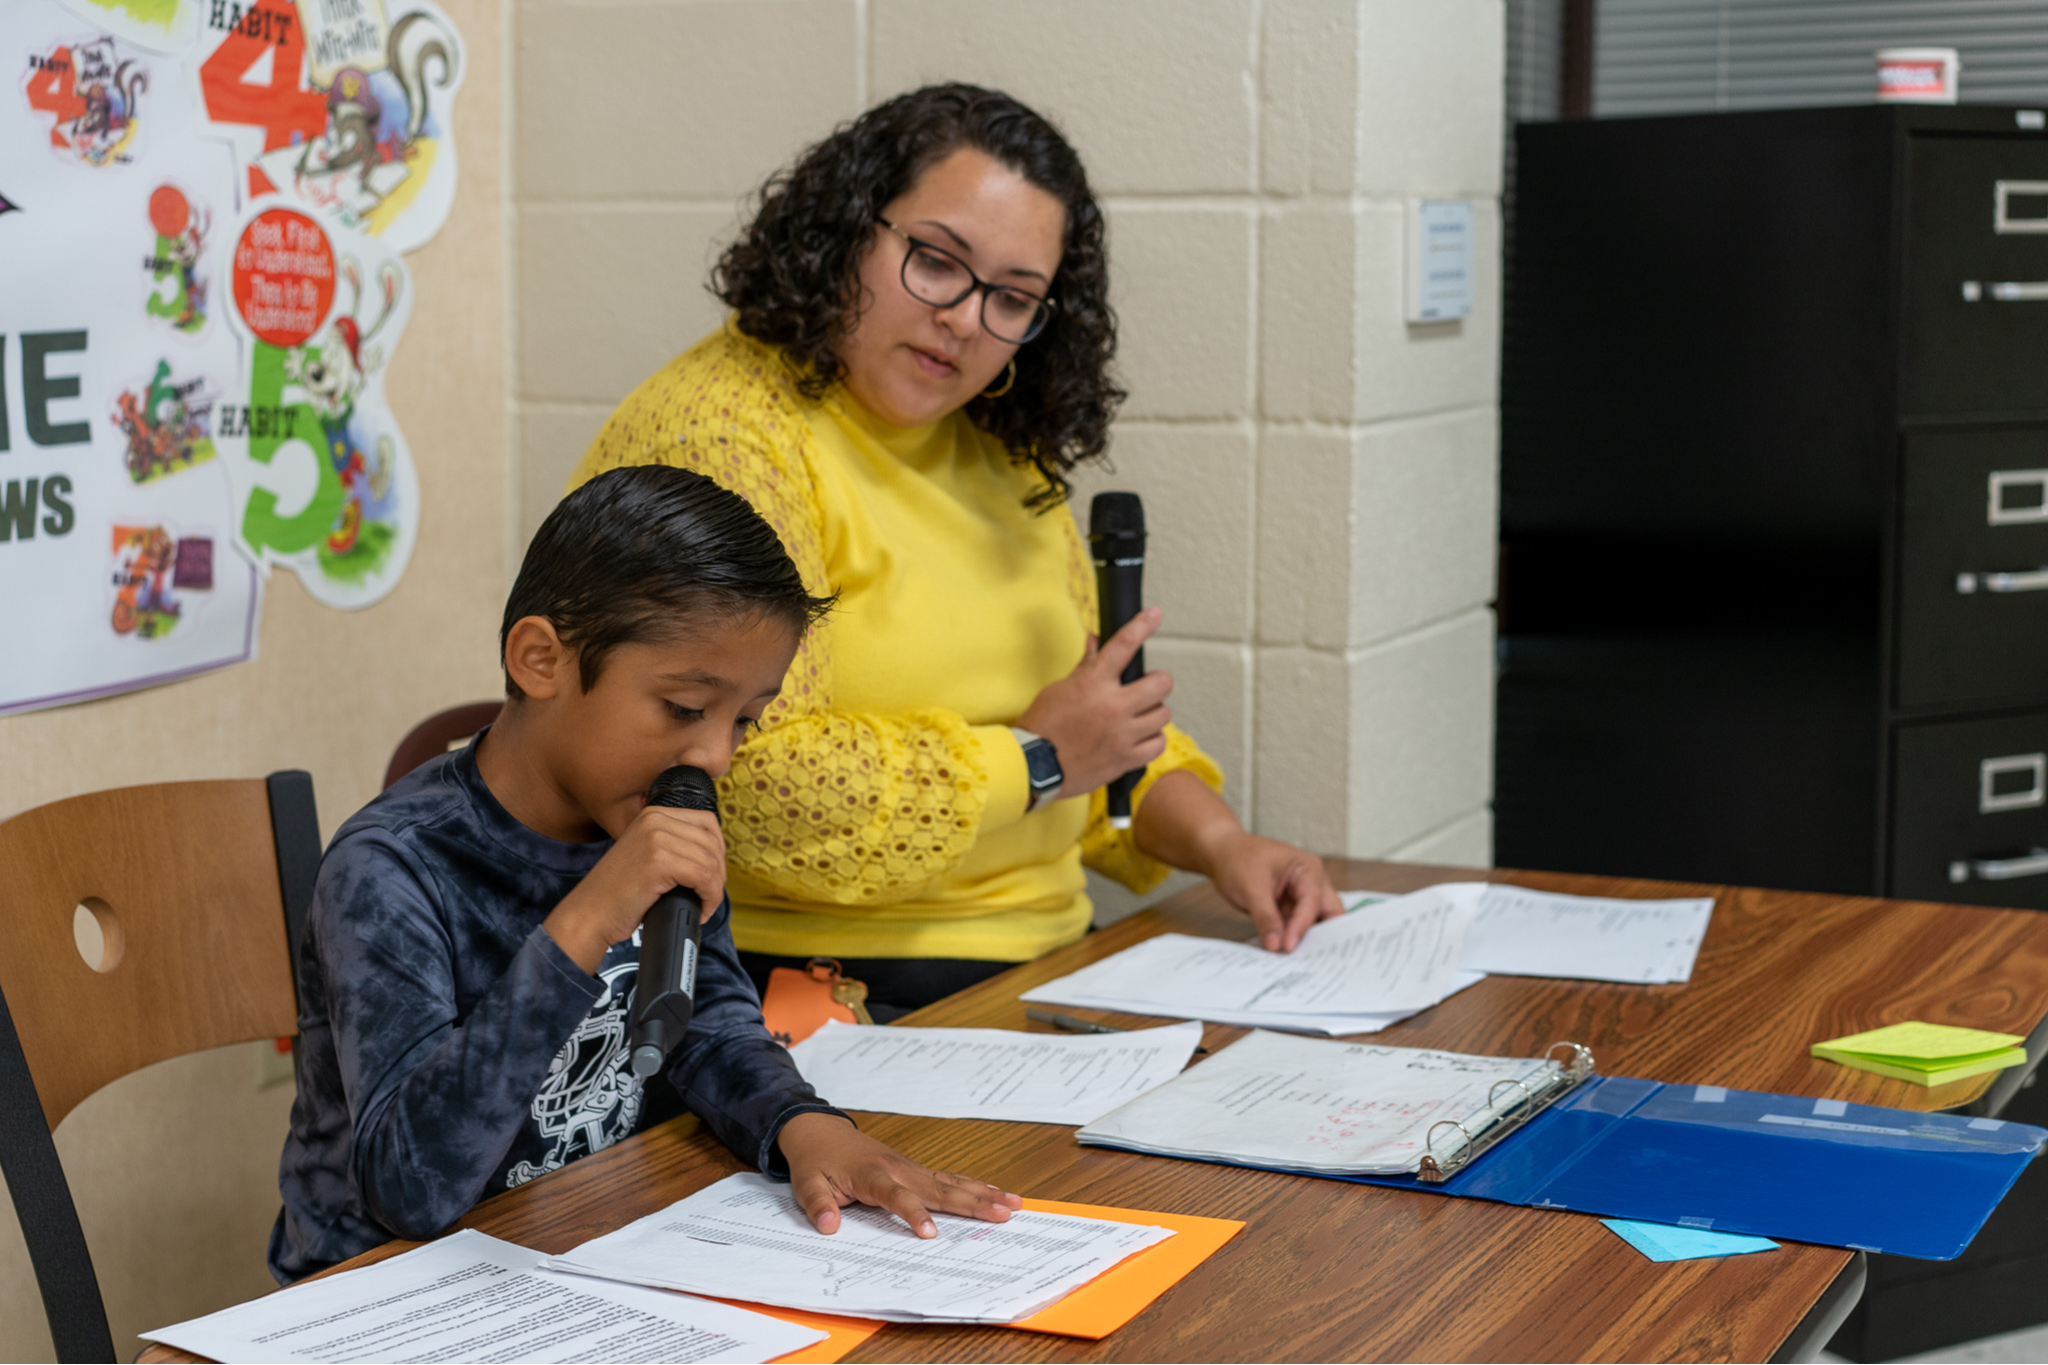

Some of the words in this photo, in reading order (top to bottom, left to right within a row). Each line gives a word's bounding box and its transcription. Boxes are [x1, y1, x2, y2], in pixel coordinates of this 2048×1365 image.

[209, 0, 292, 45] HABIT
[0, 328, 91, 452] E
[219, 405, 300, 439] HABIT
[241, 340, 345, 558] 5
